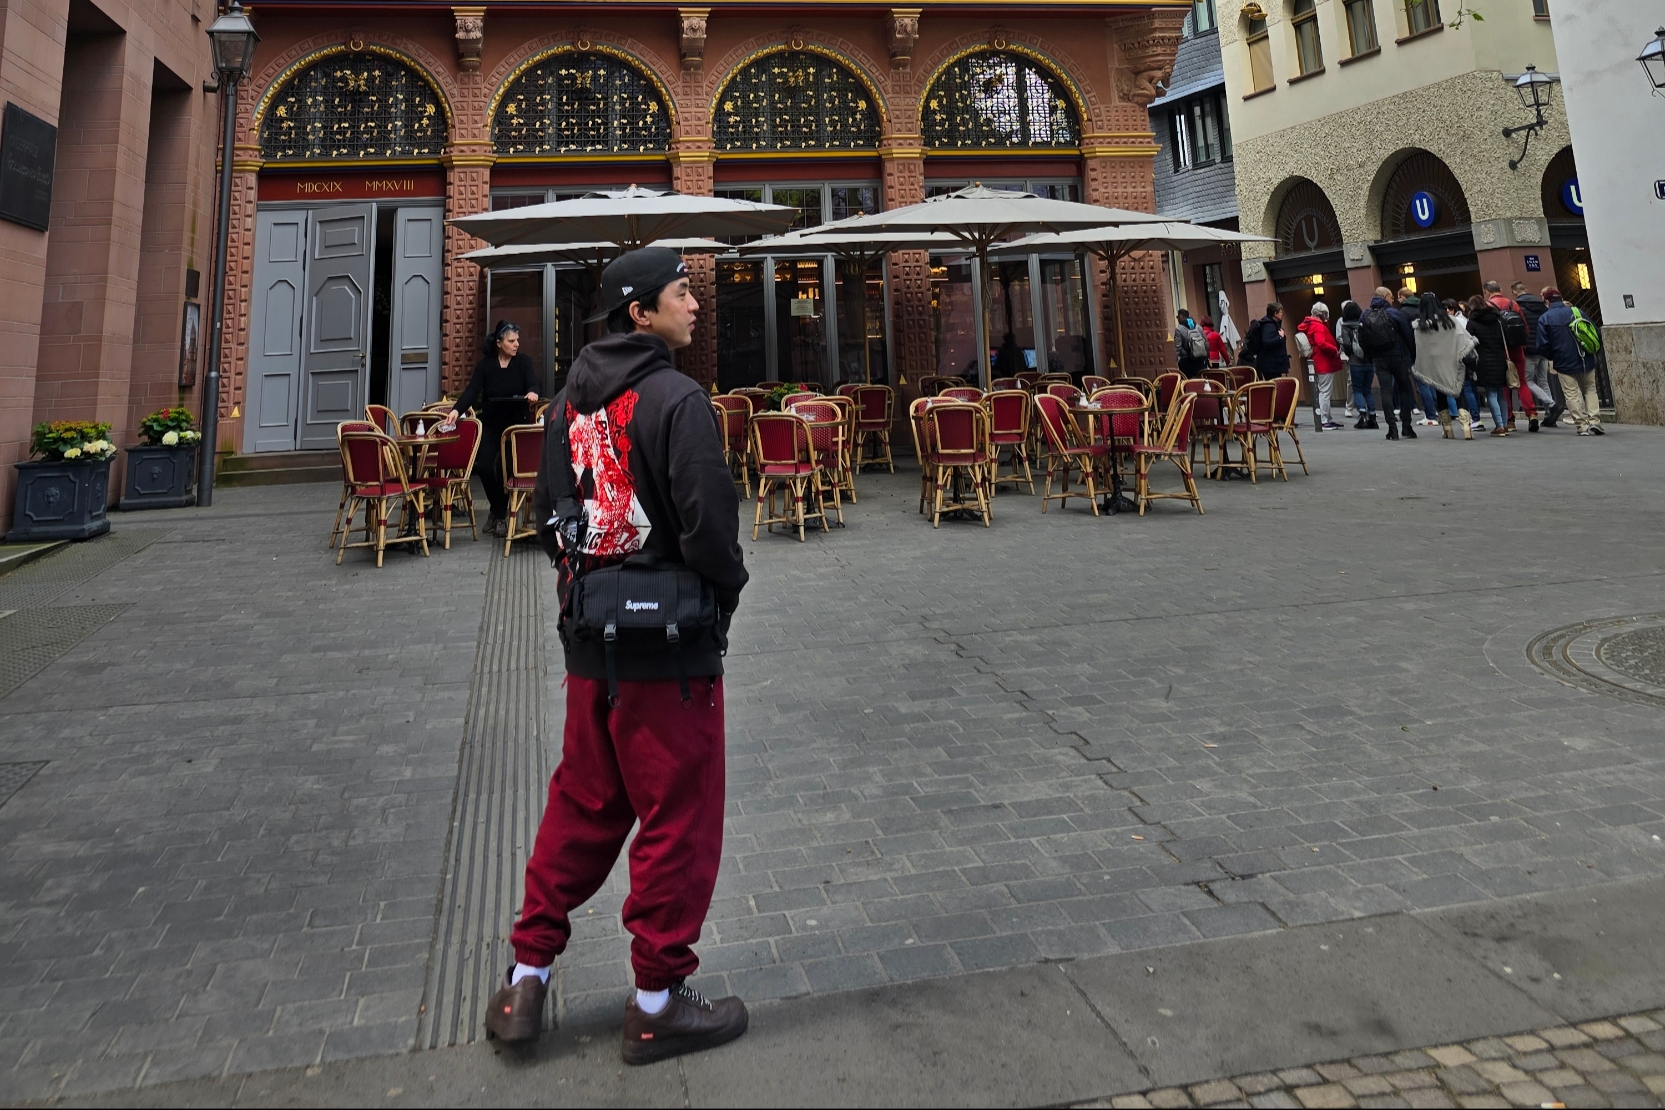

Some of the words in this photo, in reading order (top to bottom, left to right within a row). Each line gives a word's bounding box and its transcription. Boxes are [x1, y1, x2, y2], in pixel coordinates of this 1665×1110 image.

[297, 181, 343, 193] MDCXIX
[365, 179, 414, 192] MMXVIII
[1415, 198, 1430, 221] U
[625, 599, 658, 612] Supreme
